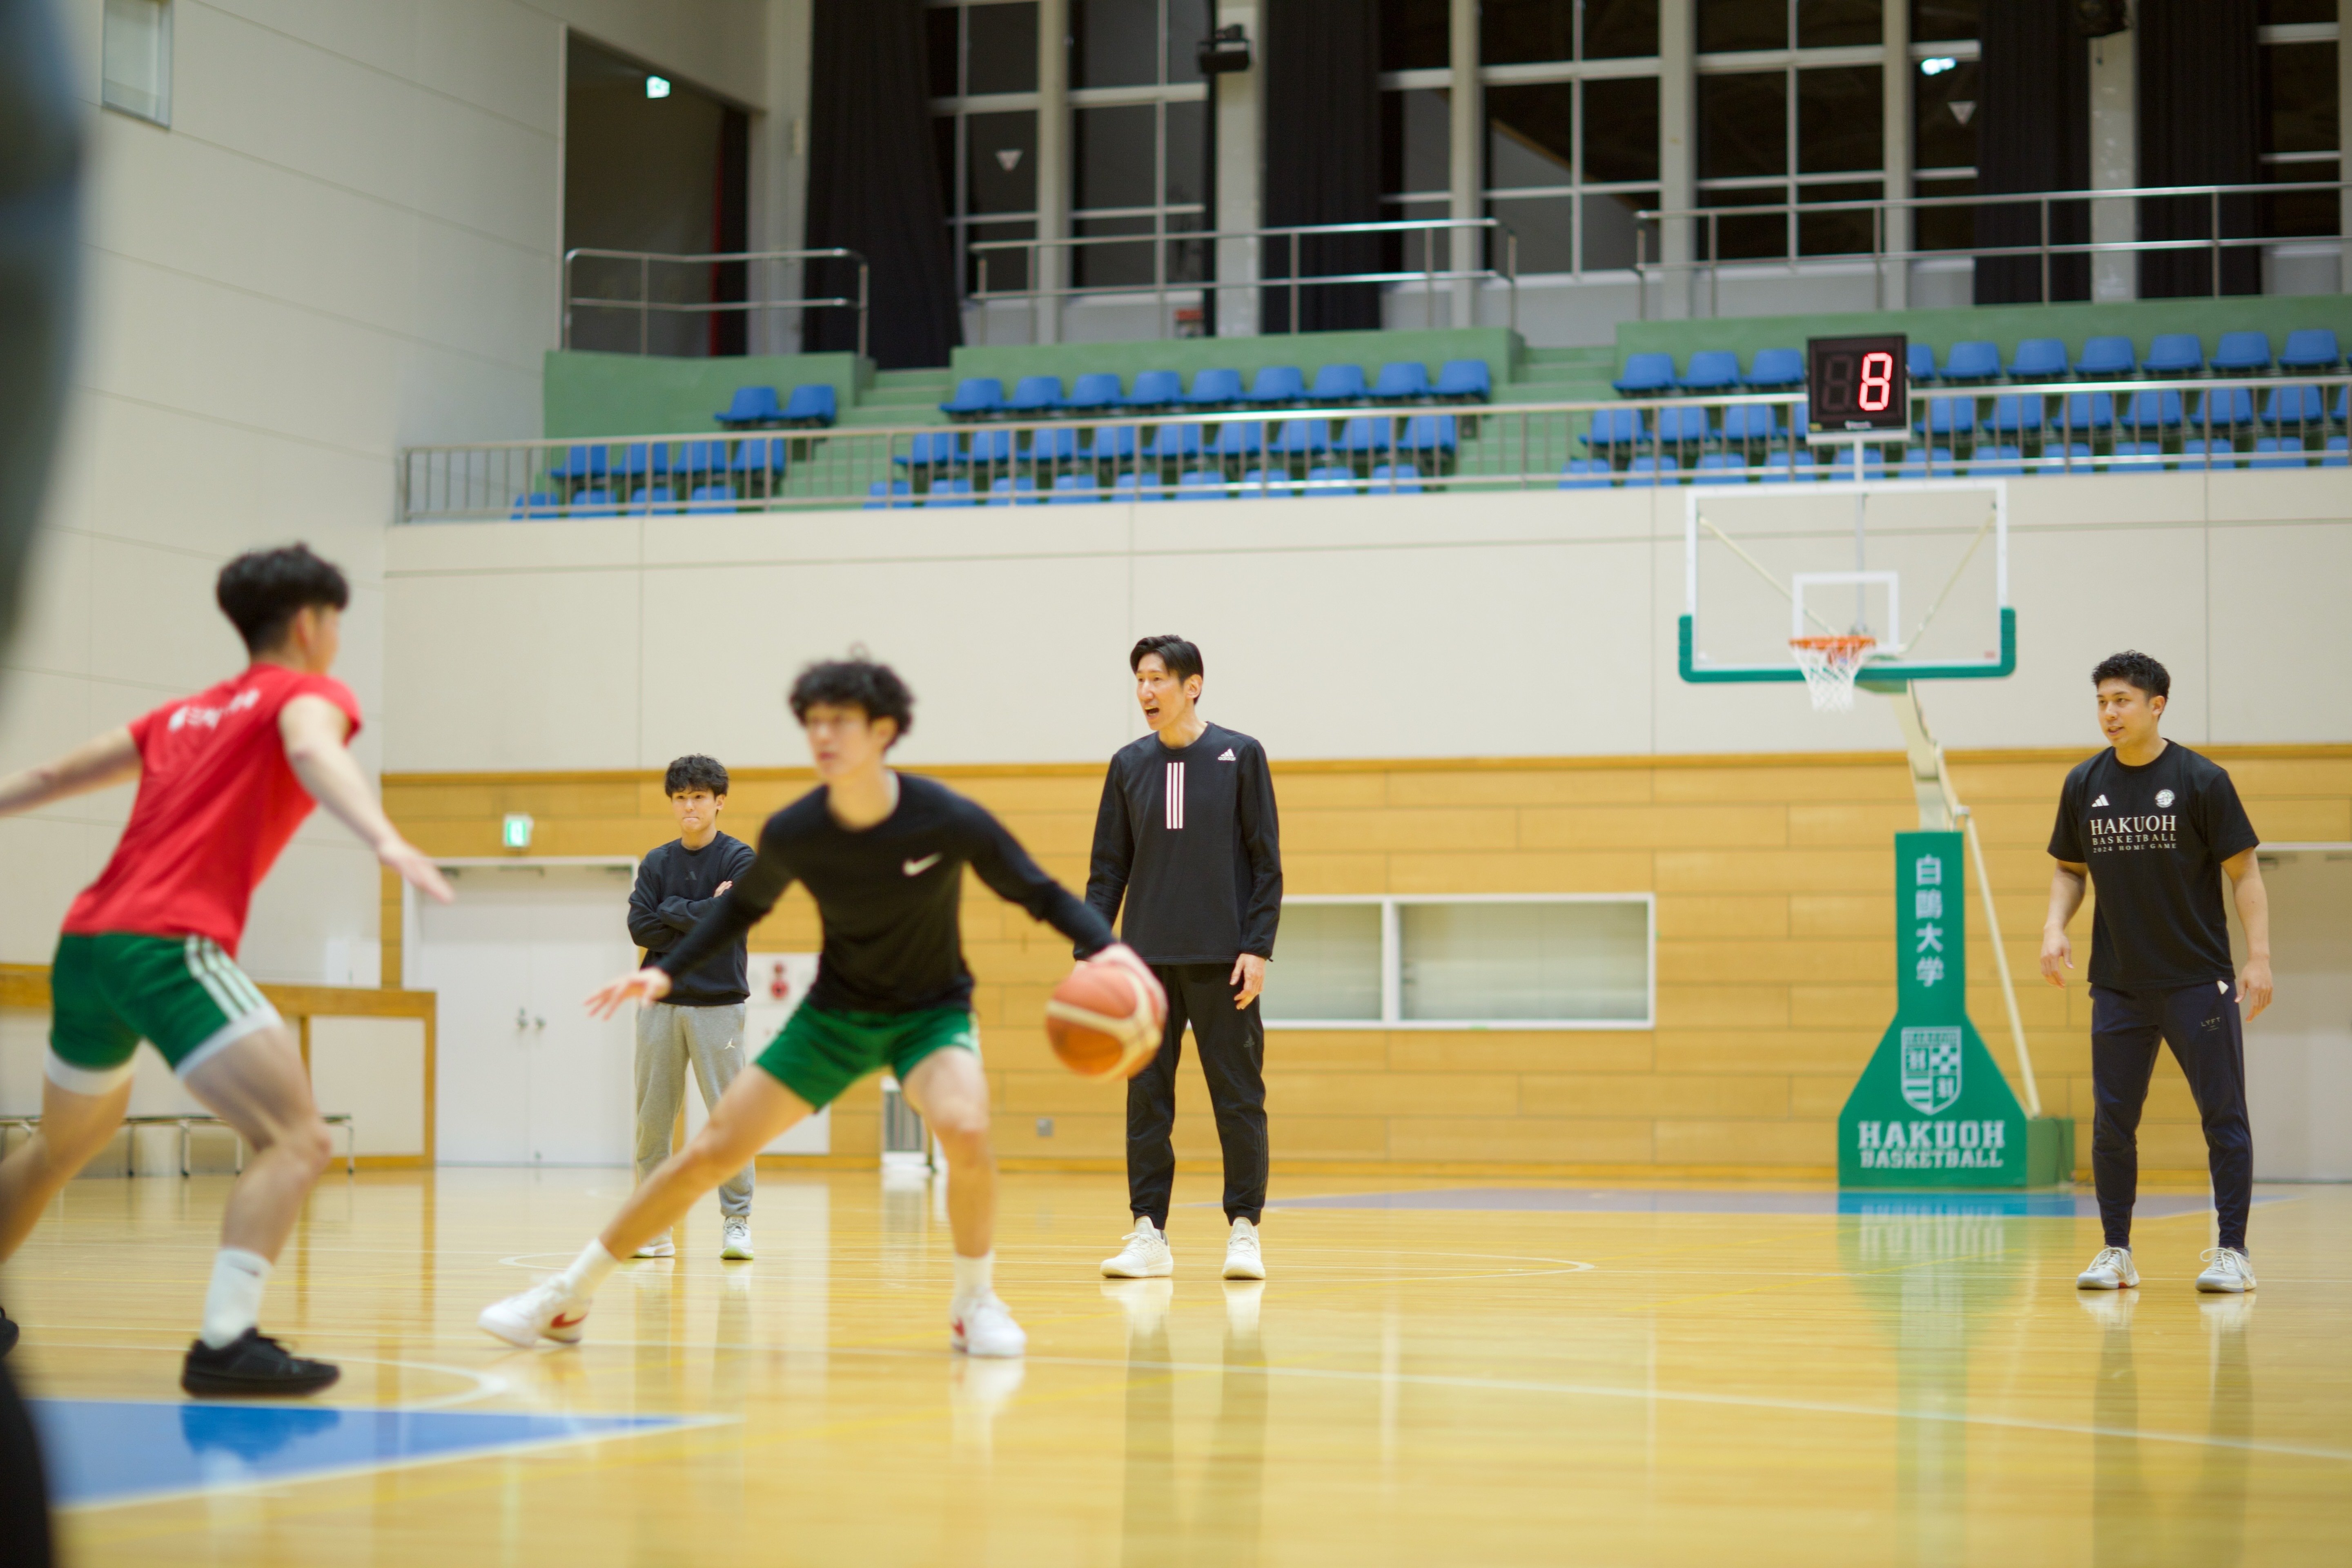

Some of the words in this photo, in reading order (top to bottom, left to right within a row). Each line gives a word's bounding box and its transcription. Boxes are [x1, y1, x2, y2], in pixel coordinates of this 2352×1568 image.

[1859, 352, 1893, 411] 8
[2090, 815, 2176, 835] HAKUOH
[2092, 833, 2176, 846] BASKETBALL
[1858, 1120, 2005, 1149] HAKUOH
[1860, 1149, 2004, 1168] BASKETBALL
